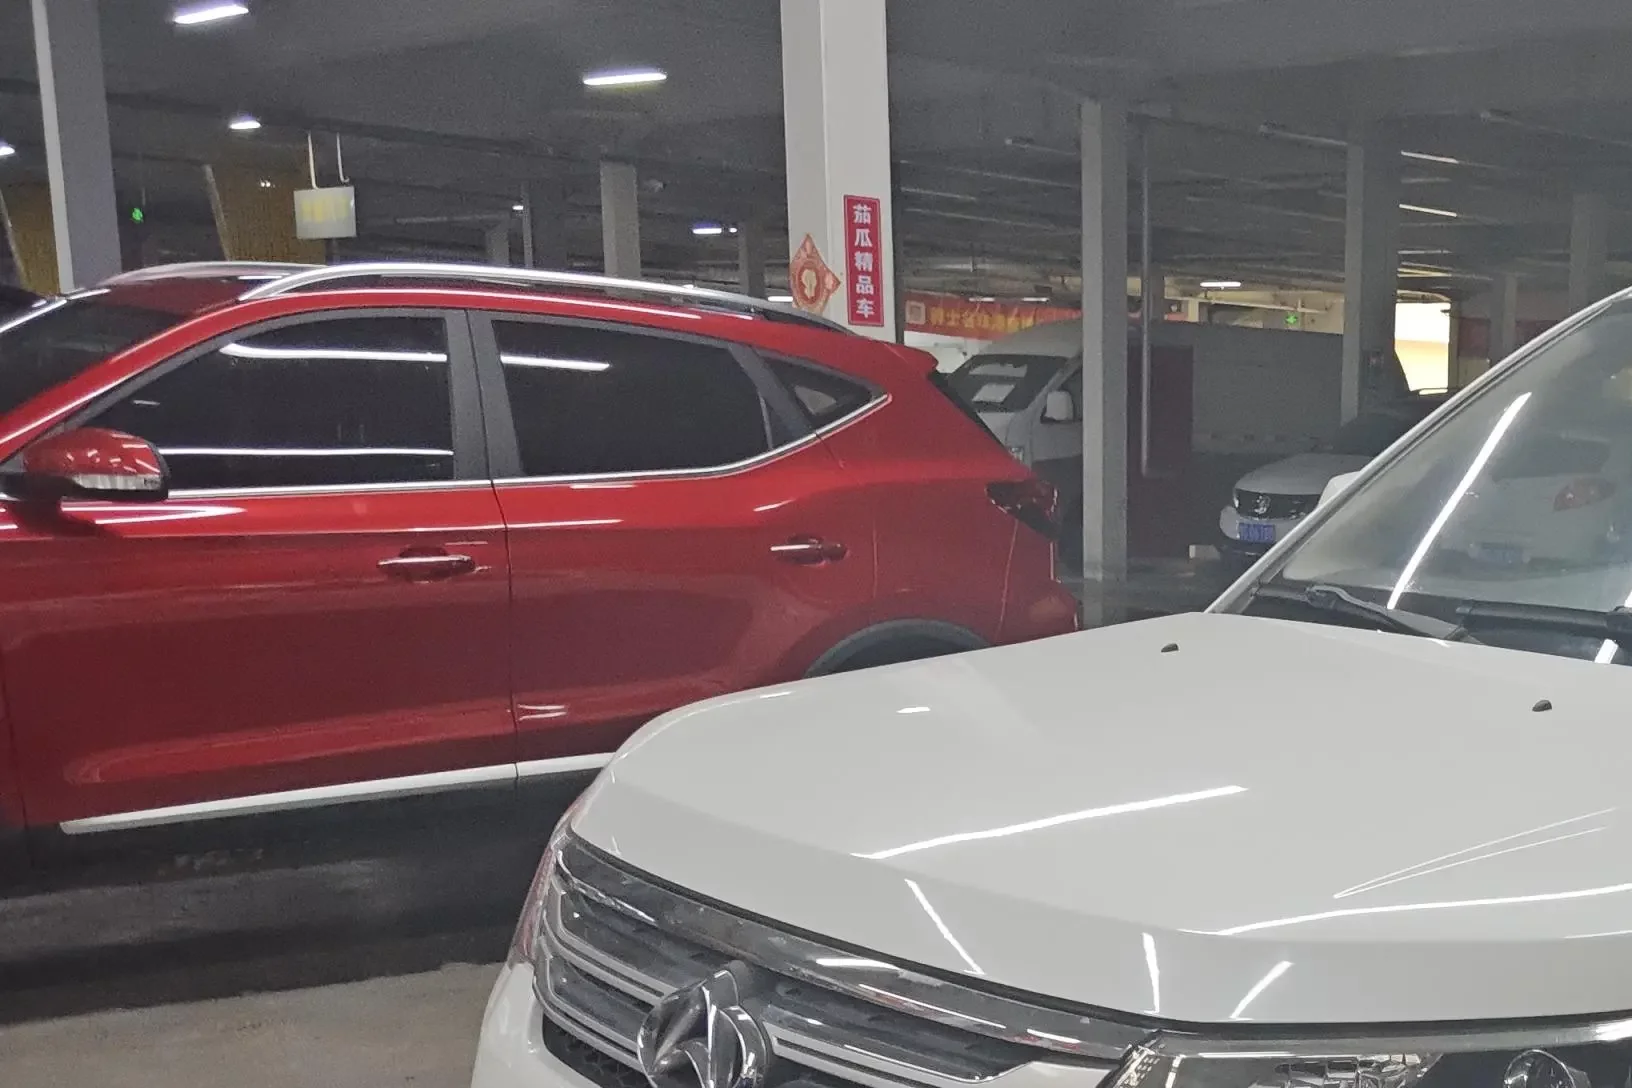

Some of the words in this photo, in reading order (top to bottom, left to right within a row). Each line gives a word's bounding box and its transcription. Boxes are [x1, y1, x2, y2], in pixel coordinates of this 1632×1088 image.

[852, 203, 875, 319] 茄瓜精品车
